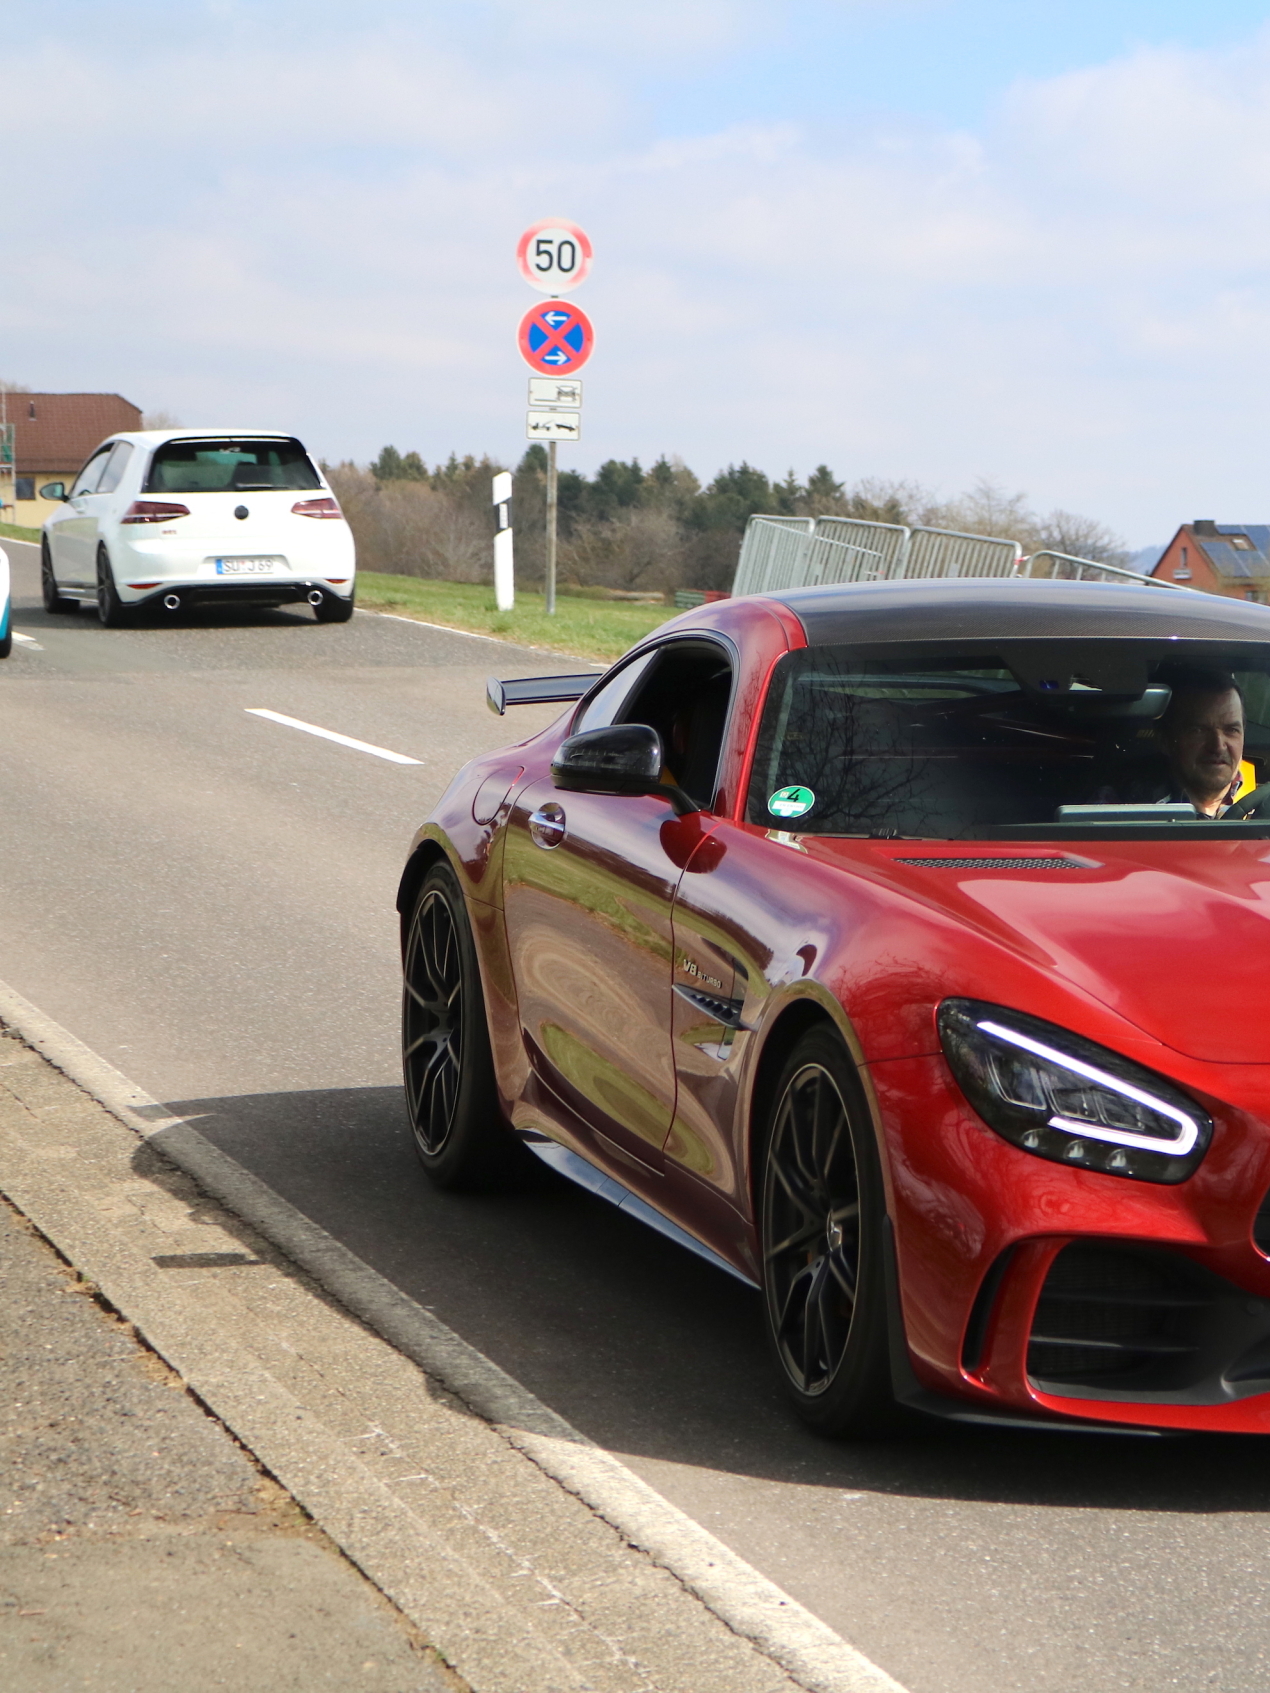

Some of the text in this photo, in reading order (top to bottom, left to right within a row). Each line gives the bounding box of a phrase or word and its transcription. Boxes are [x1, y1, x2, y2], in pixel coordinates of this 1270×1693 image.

[535, 239, 576, 273] 50
[225, 560, 240, 572] SU
[786, 788, 801, 802] 4
[683, 959, 723, 989] V8 BITURBO
